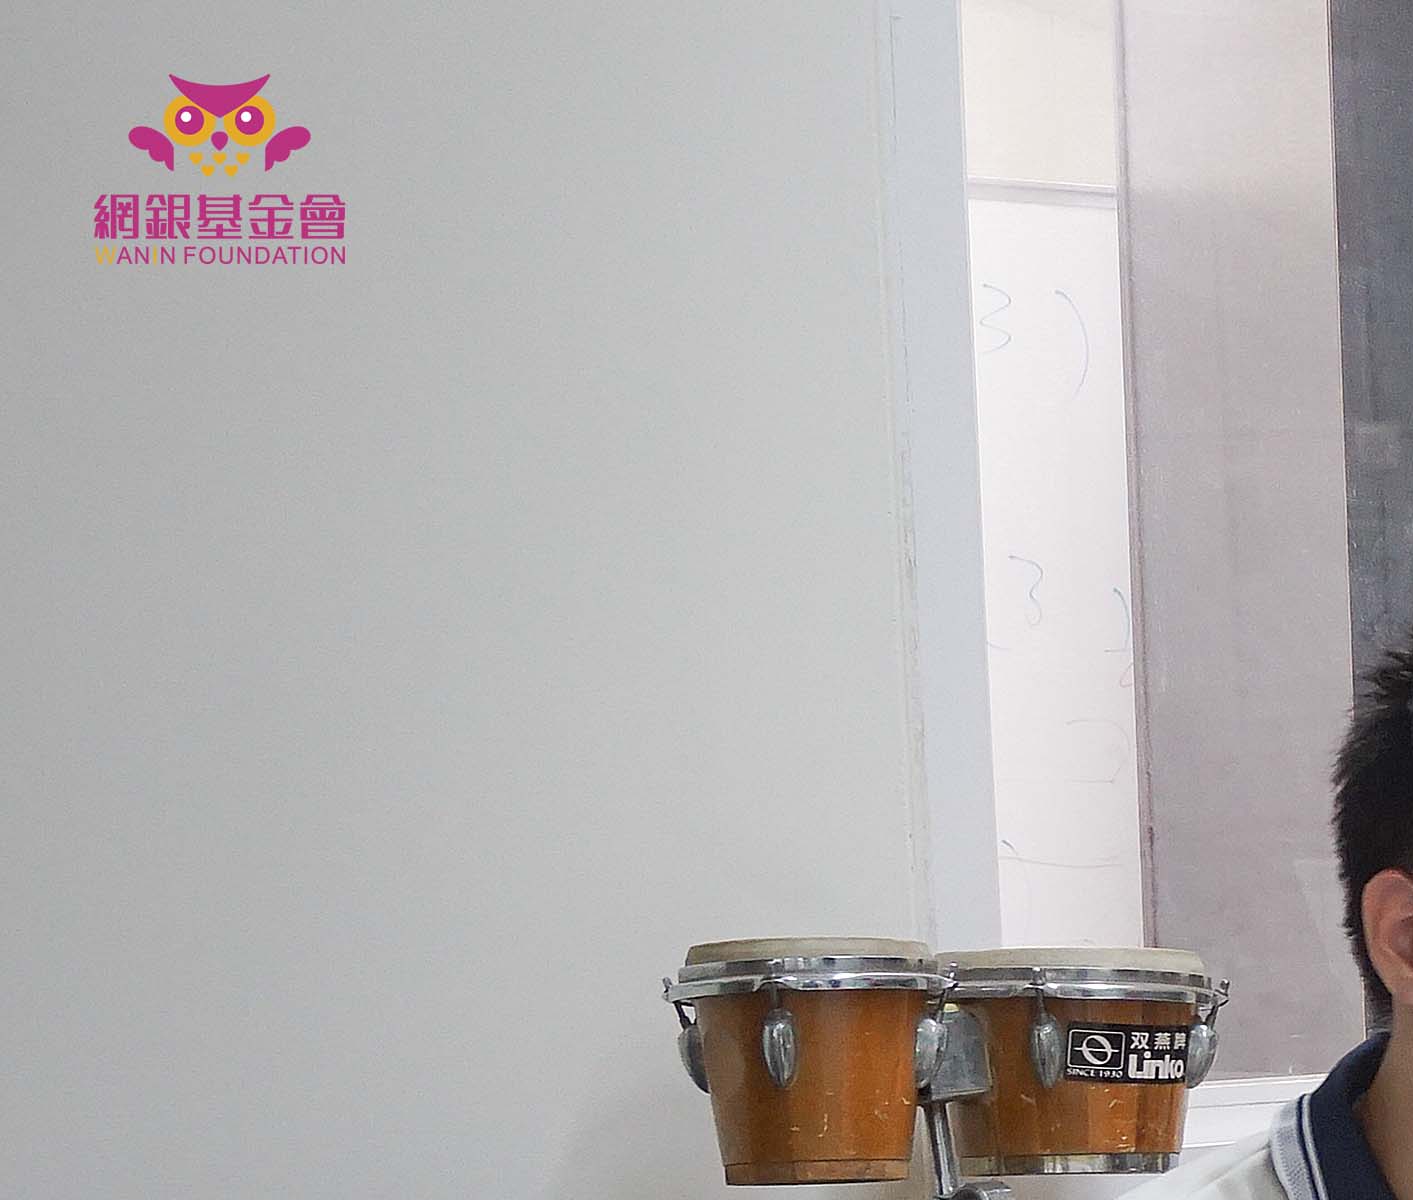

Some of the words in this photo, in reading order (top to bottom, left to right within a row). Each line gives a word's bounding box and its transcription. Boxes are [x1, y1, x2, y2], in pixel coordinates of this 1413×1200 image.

[1066, 1067, 1096, 1078] SINCE
[1099, 1069, 1124, 1079] 1930
[1128, 1051, 1184, 1079] Linko
